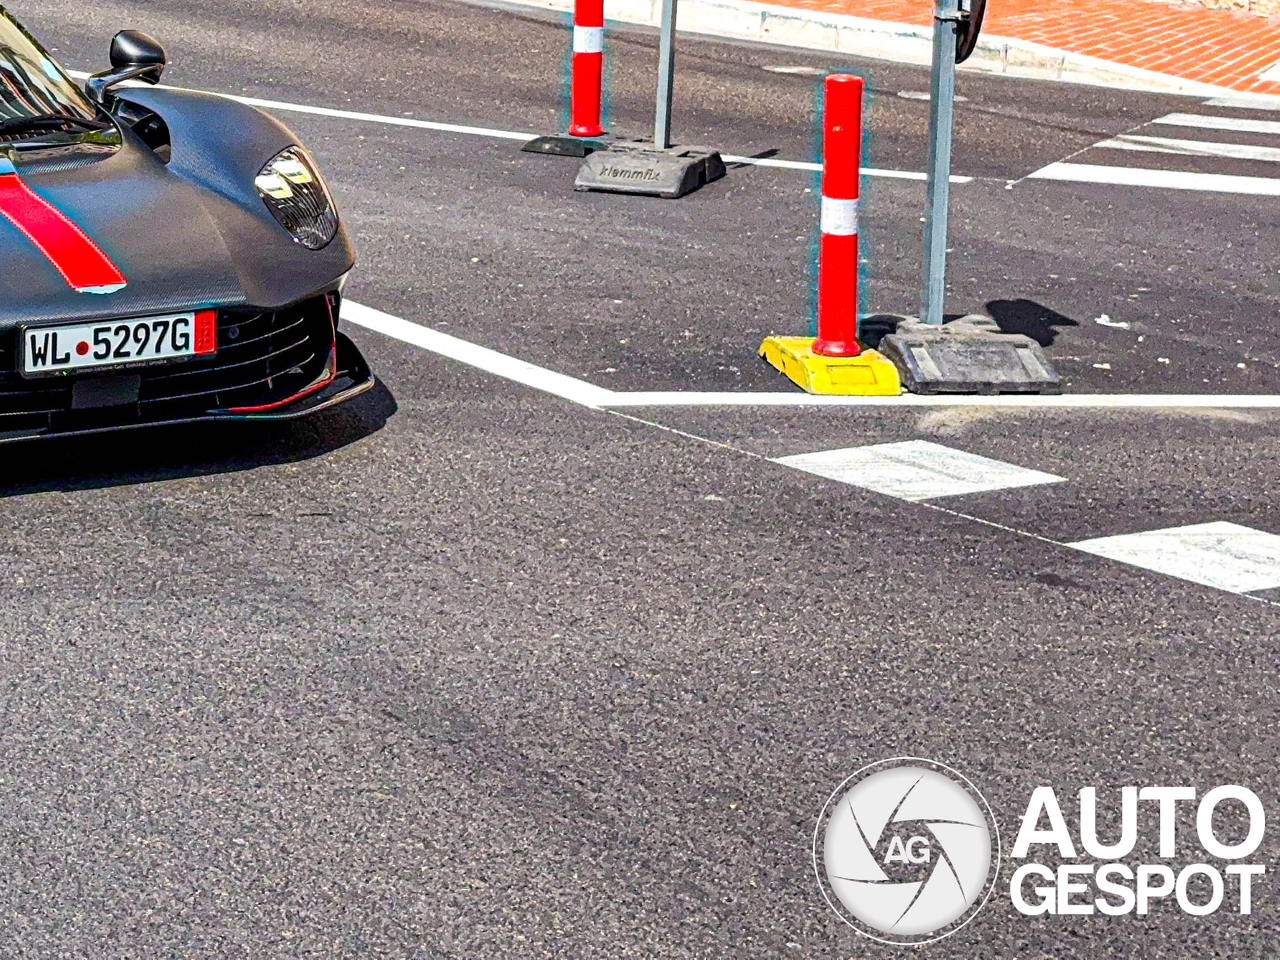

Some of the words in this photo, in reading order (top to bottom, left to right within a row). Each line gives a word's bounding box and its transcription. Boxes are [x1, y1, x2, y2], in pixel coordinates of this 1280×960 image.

[599, 165, 661, 182] klemmfix
[30, 332, 70, 367] WL
[93, 317, 190, 360] 5297G
